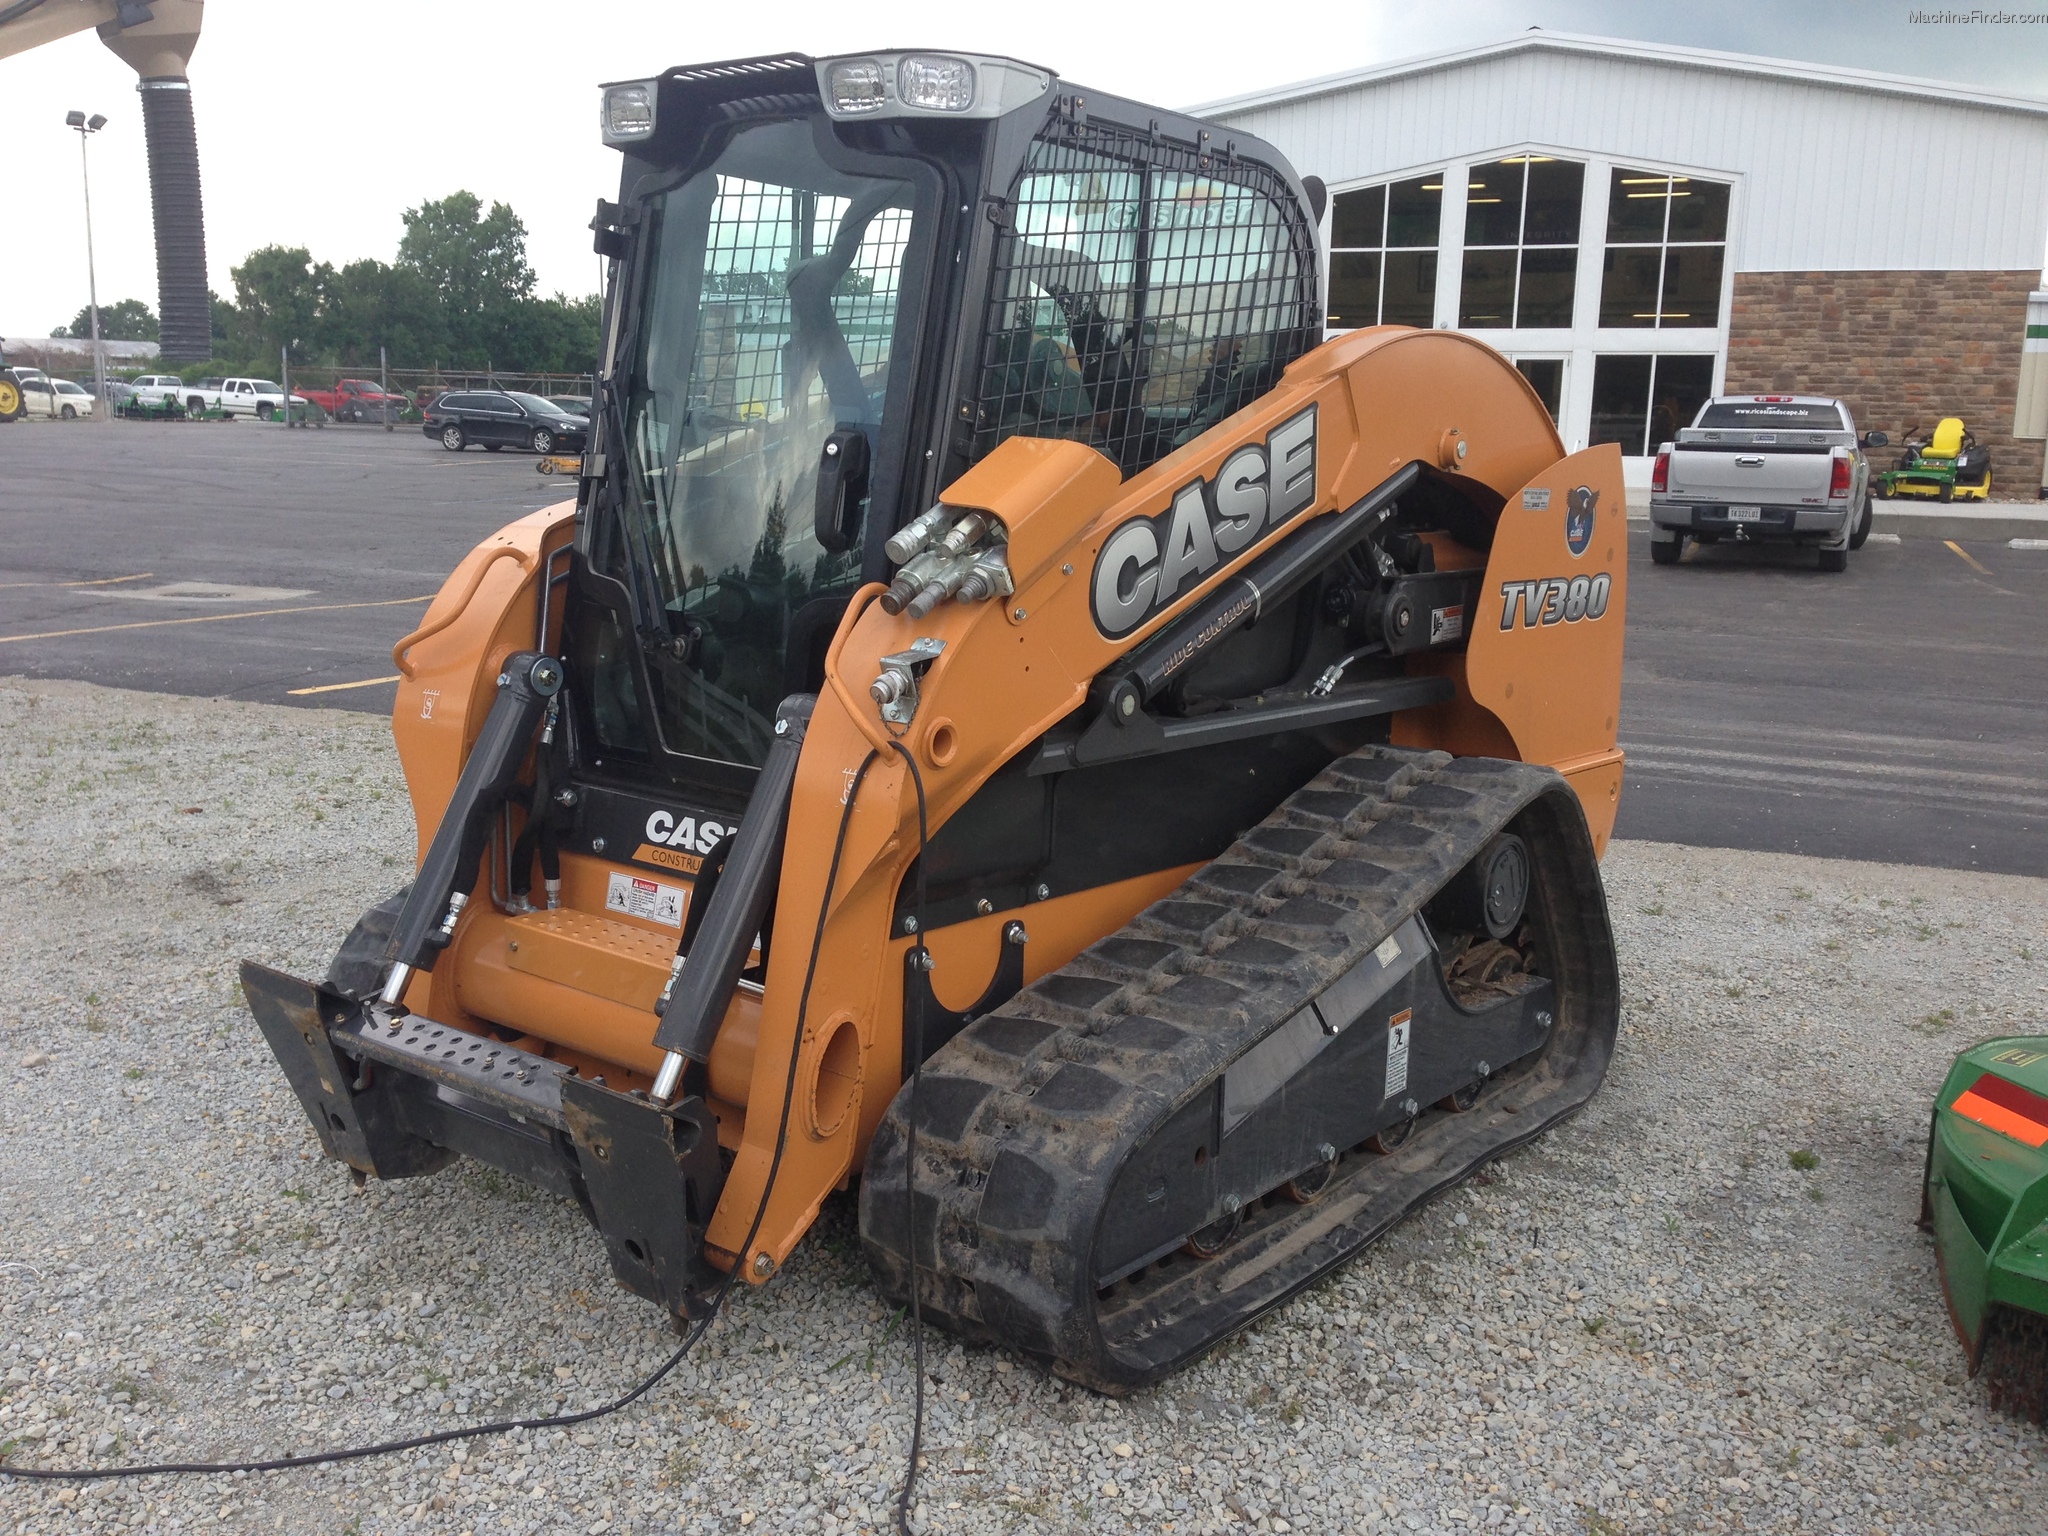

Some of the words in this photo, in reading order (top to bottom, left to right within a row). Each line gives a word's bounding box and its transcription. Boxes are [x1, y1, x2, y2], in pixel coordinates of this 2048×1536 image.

[1507, 231, 1570, 239] INEGRITY
[1094, 408, 1315, 635] CASE
[1161, 641, 1195, 677] RIDE
[1195, 597, 1252, 649] CONTROL
[1500, 572, 1612, 632] TV380
